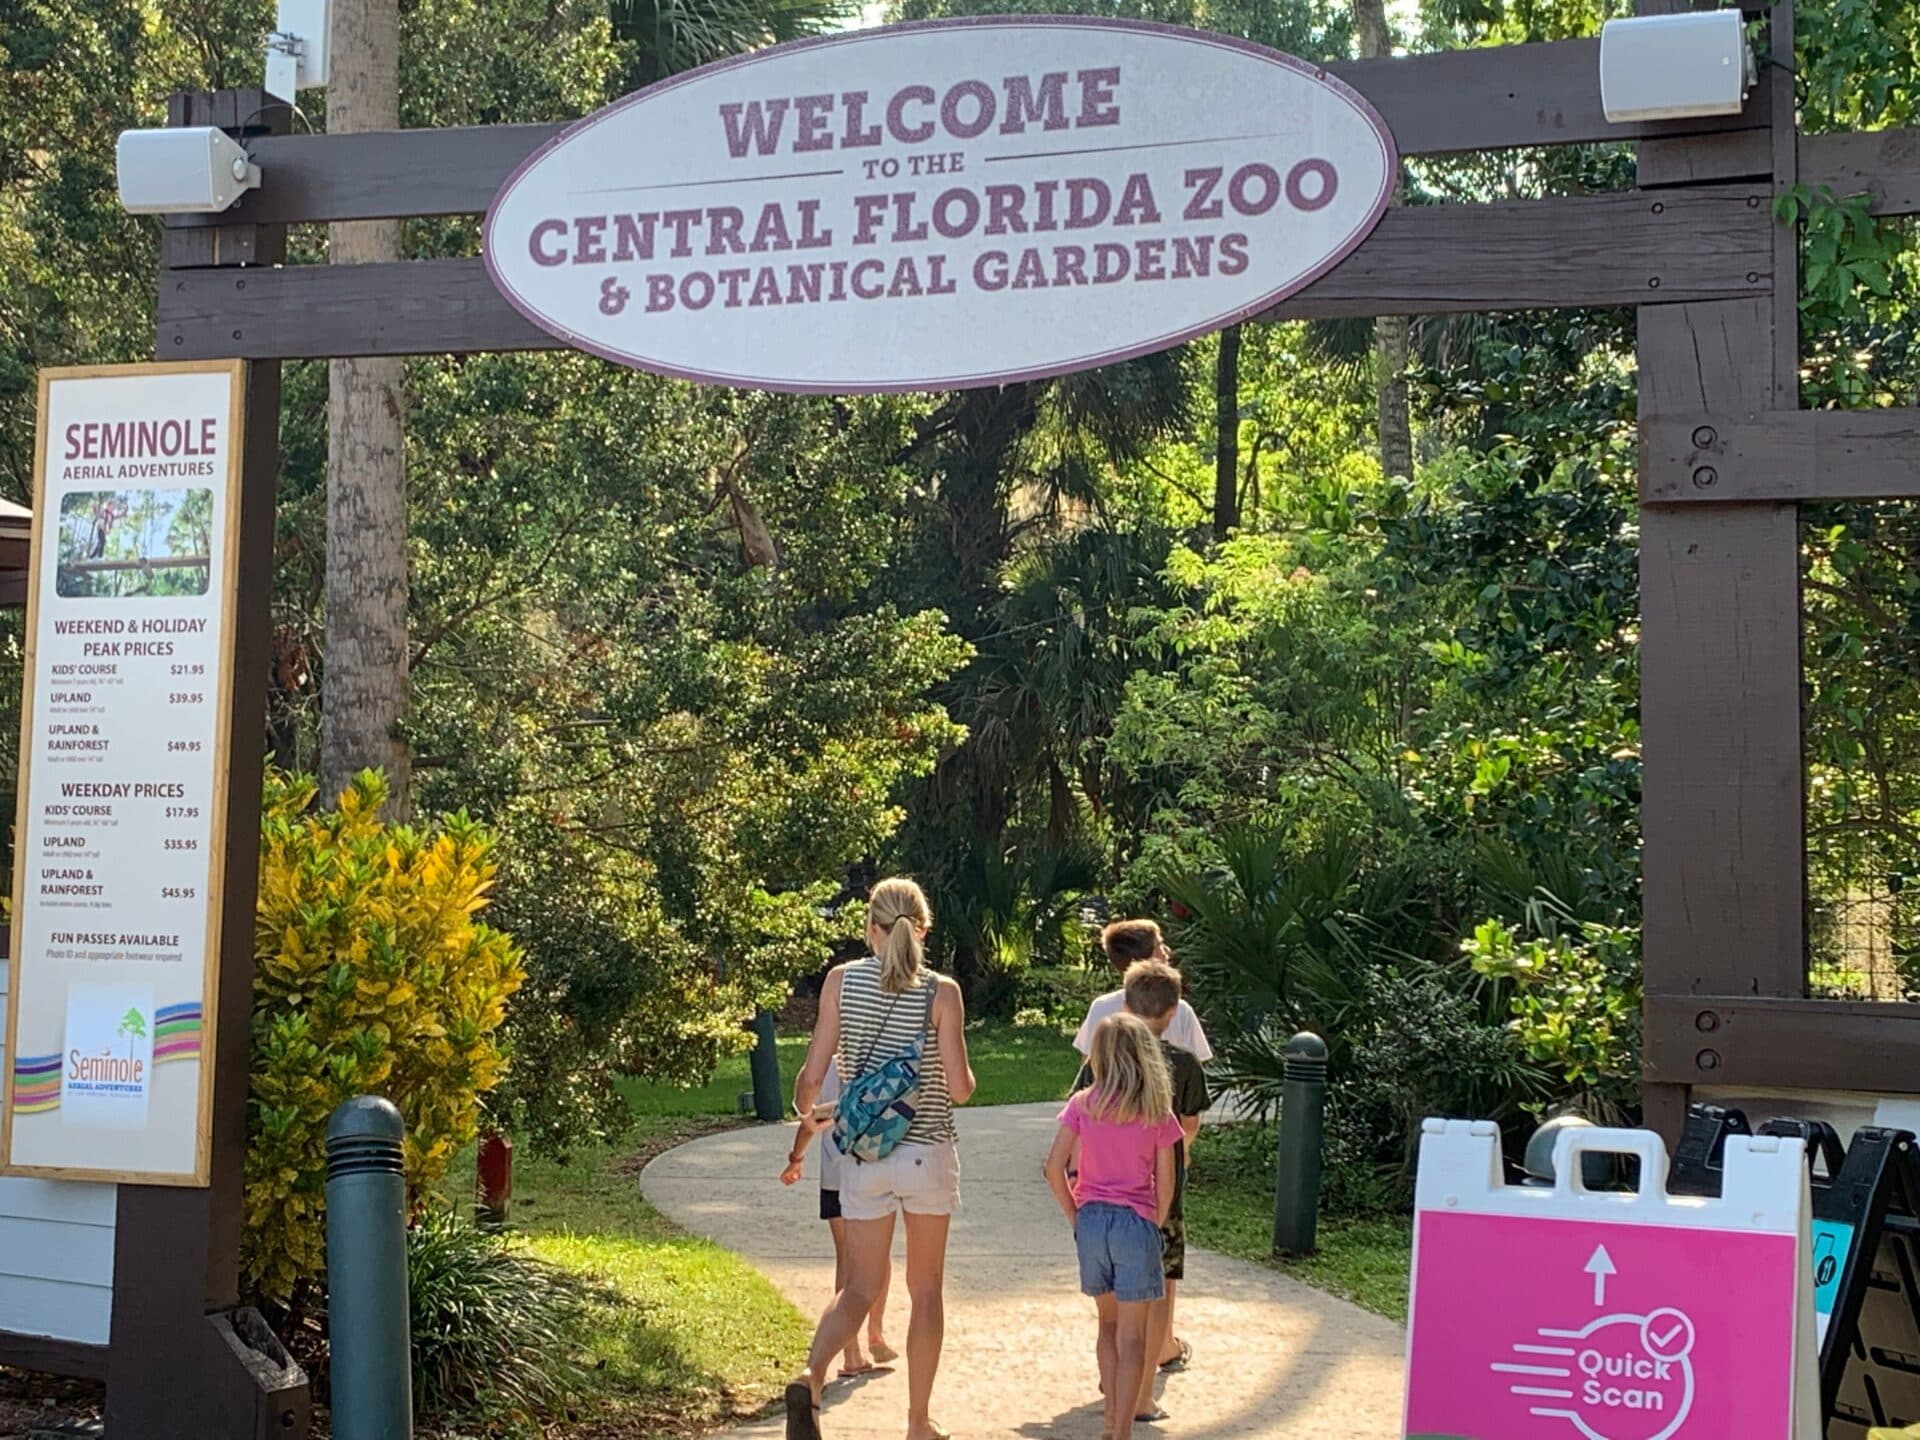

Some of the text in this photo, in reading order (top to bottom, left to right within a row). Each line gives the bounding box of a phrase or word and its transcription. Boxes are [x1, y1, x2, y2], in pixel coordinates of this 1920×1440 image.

[719, 66, 1121, 158] WELCOME
[862, 152, 965, 179] TO THE
[529, 157, 1338, 267] CENTRAL FLORIDA ZOO
[599, 233, 1249, 316] & BOTANICAL GARDENS
[65, 418, 216, 460] SEMINOLE
[63, 462, 214, 480] AERIAL ADVENTURES
[55, 618, 207, 634] WEEKEND & HOLIDAY
[83, 641, 173, 656] PEAK PRICES
[51, 664, 117, 675] KIDS' COURSE
[170, 664, 205, 676] $21.95
[50, 692, 91, 703] UPLAND
[169, 692, 203, 704] $39.95
[48, 724, 99, 735] UPLAND &
[48, 740, 110, 751] RAINFOREST
[167, 741, 202, 752] $49.95
[61, 783, 184, 798] WEEKDAY PRICES
[45, 805, 112, 816] KIDS' COURSE
[165, 807, 199, 818] $17.95
[43, 836, 86, 847] UPLAND
[164, 839, 197, 850] $35.95
[41, 868, 93, 880] UPLAND &
[40, 884, 104, 896] RAINFOREST
[161, 888, 195, 899] $45.95
[51, 932, 179, 946] FUN PASSES AVAILABLE
[69, 1049, 143, 1082] Seminole
[1578, 1349, 1672, 1380] Quick
[1583, 1380, 1663, 1410] Scan
